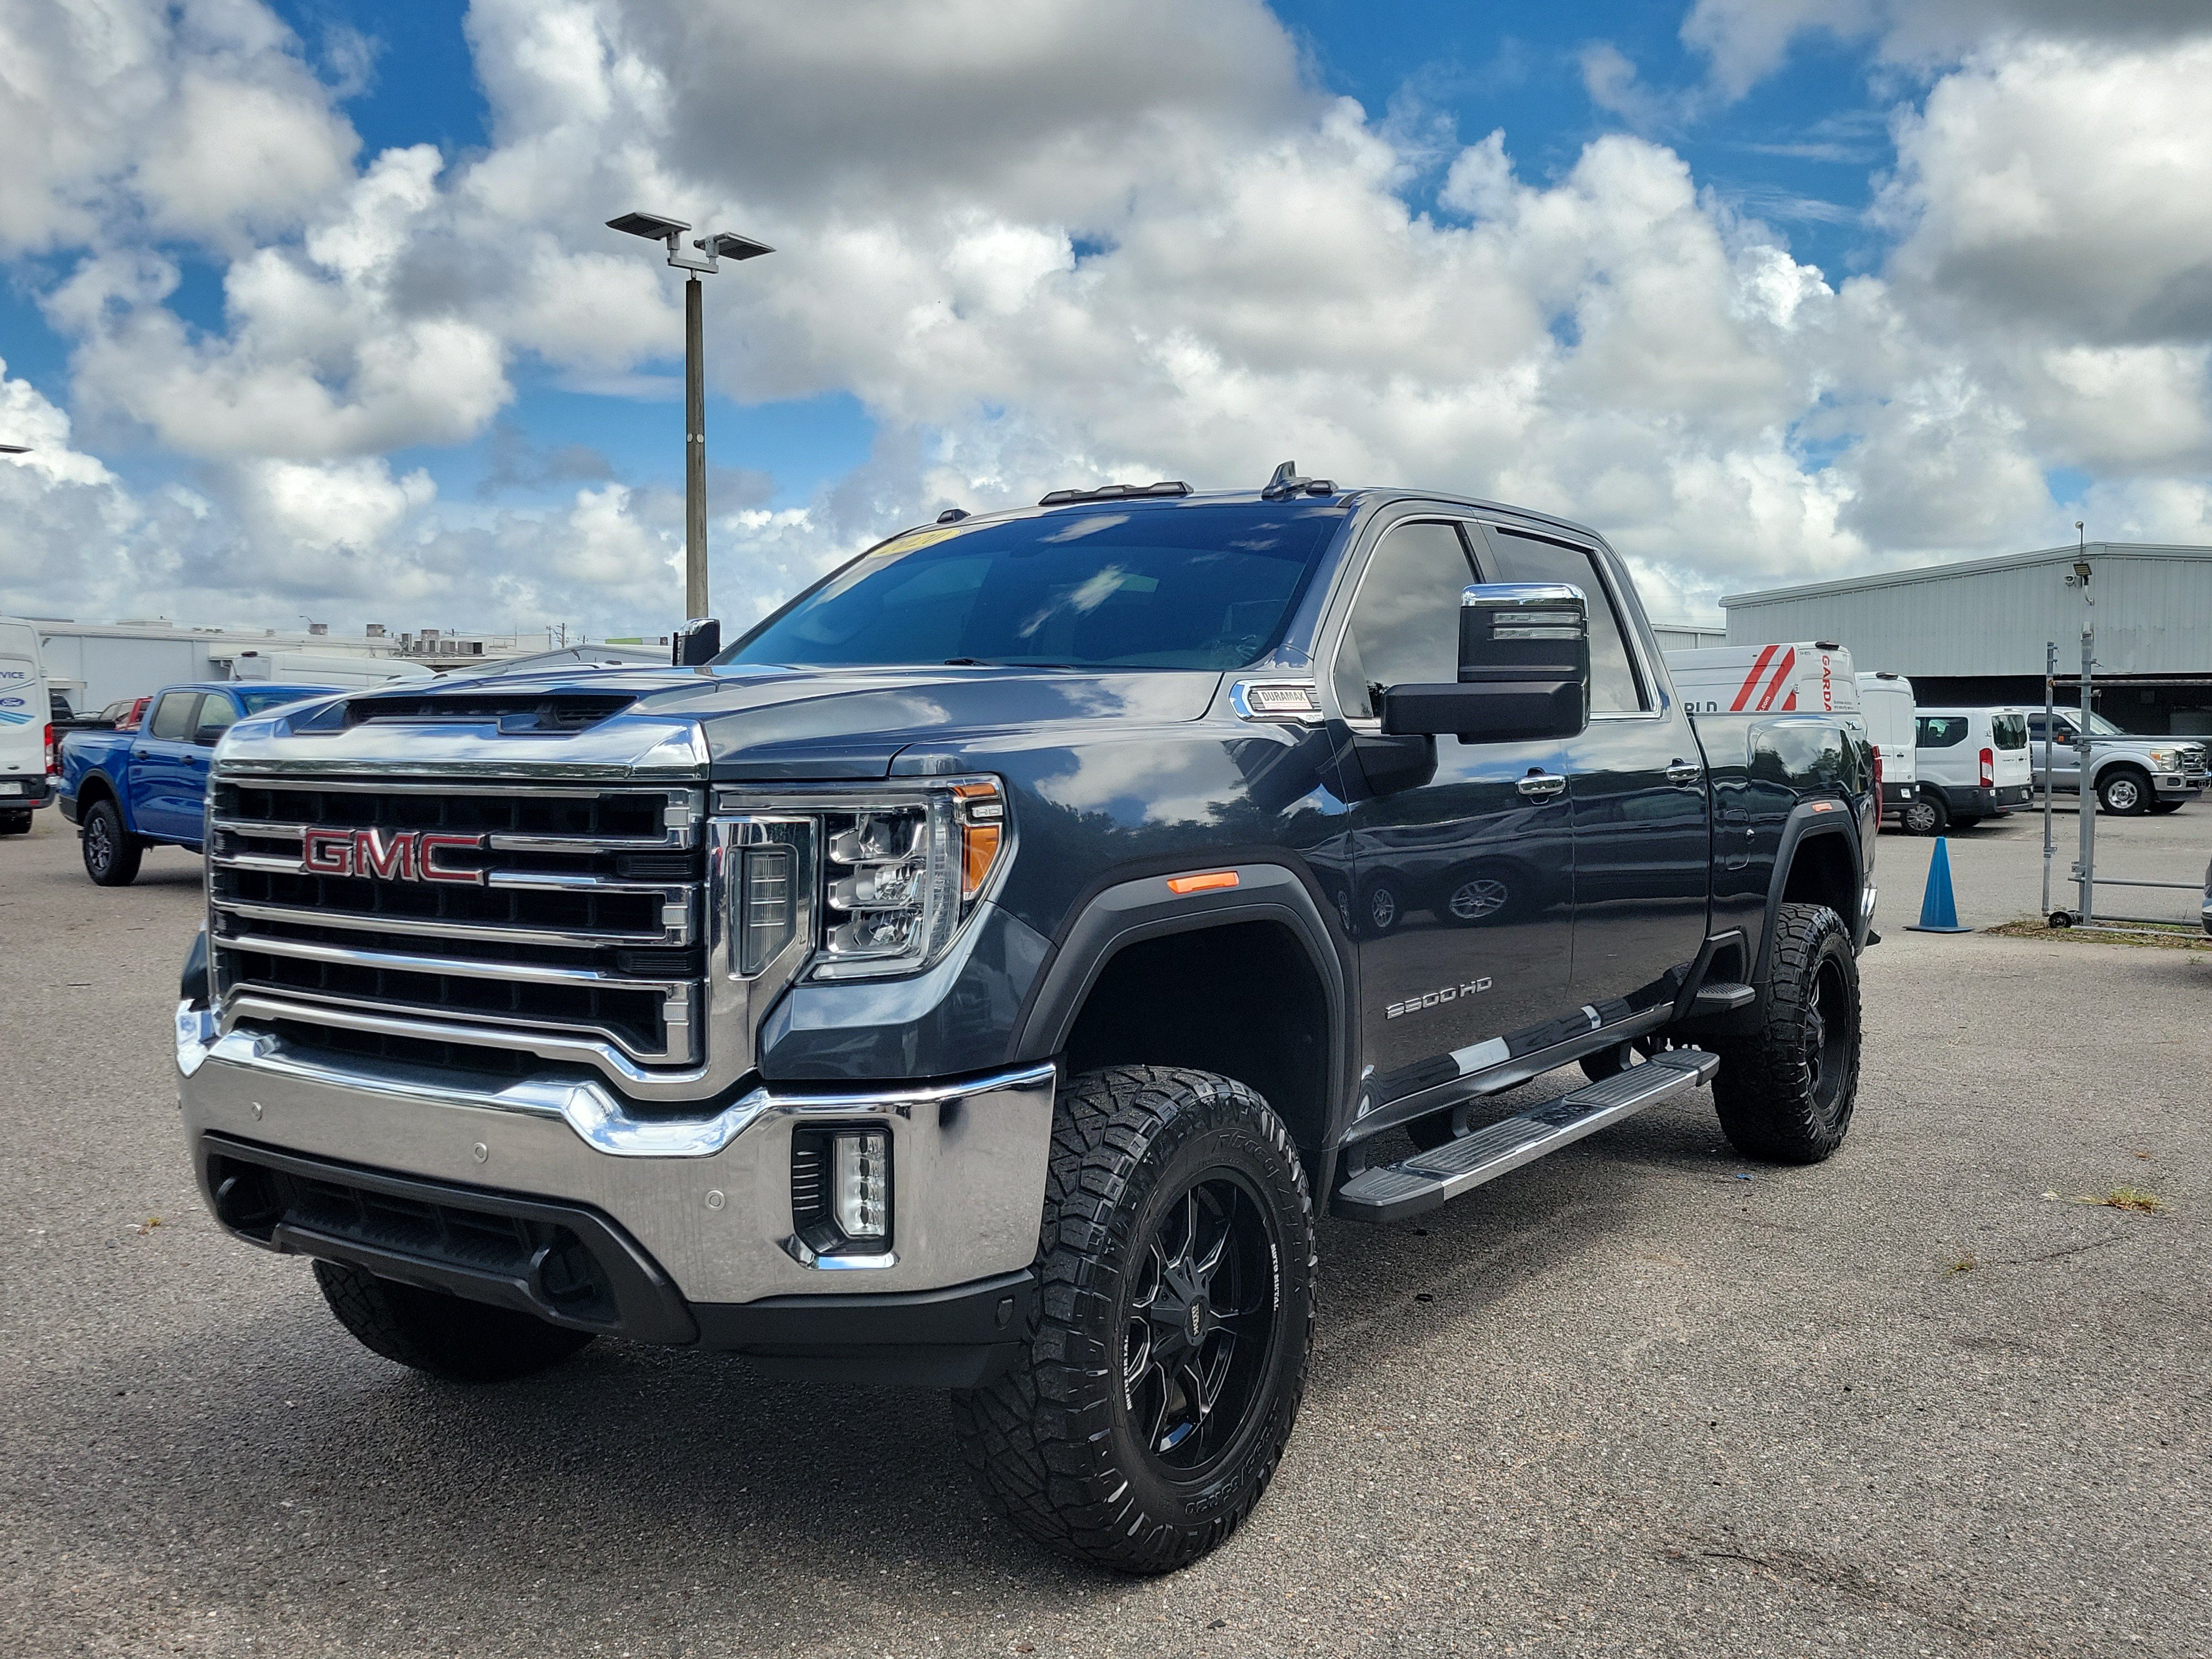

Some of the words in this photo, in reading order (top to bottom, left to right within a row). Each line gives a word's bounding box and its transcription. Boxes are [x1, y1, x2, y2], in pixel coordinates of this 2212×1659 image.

[0, 671, 25, 679] VICE
[1822, 654, 1832, 712] GARDA
[1261, 691, 1306, 702] DURAMAX
[1759, 696, 1771, 712] .com
[303, 827, 486, 887] GMC
[1385, 987, 1457, 1020] 2500
[1458, 977, 1493, 998] HD
